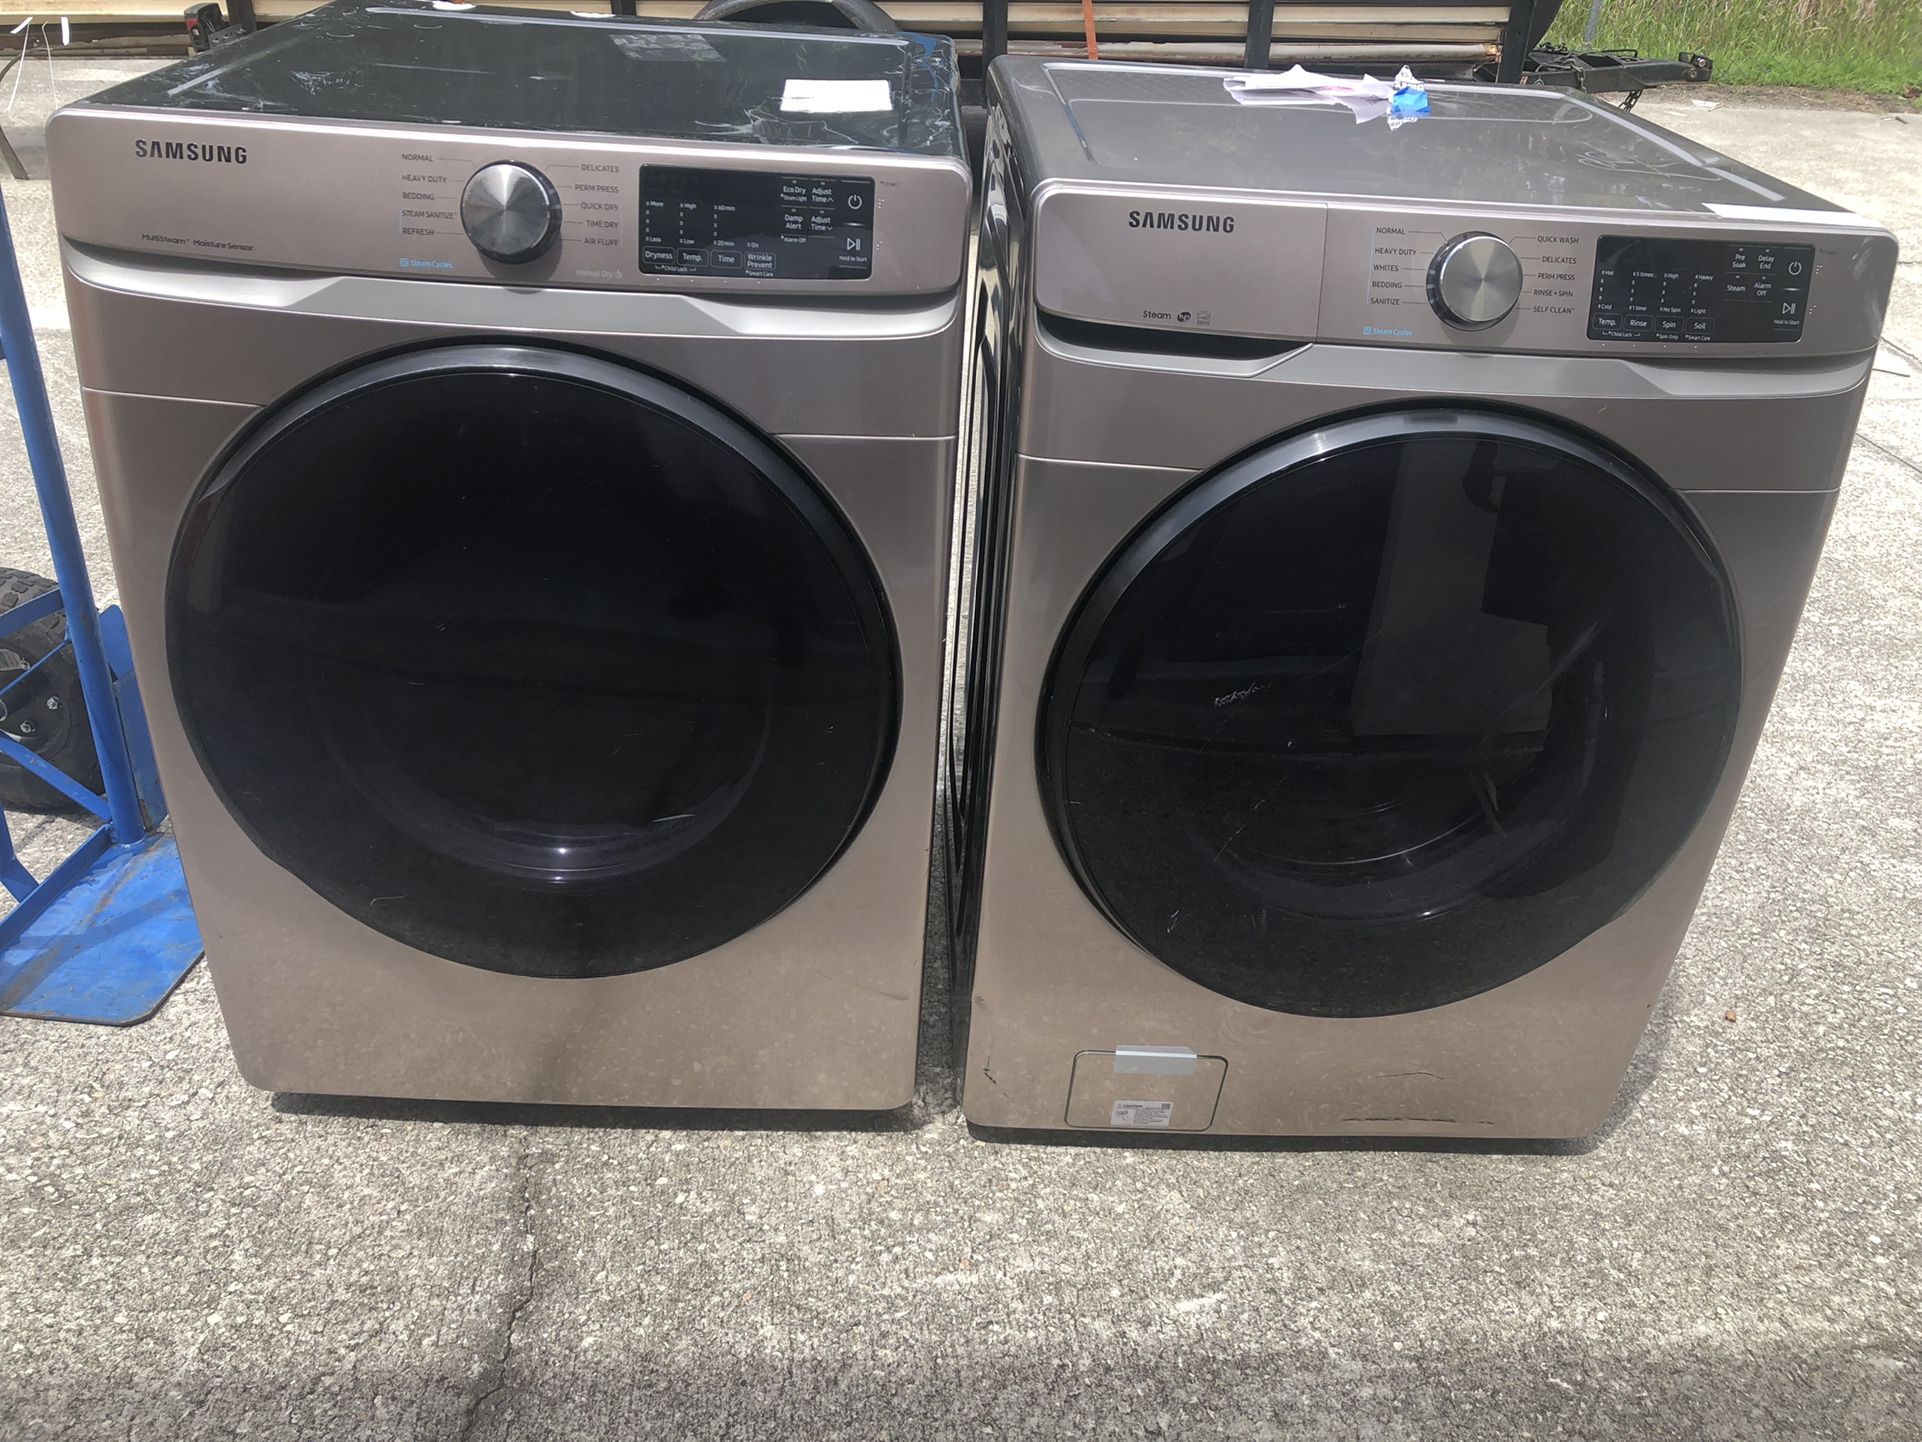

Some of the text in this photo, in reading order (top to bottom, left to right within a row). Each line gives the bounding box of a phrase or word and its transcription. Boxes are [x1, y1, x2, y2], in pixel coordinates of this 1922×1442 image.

[135, 139, 247, 164] SAMSUNG
[401, 153, 433, 162] NORMAL
[580, 163, 620, 173] DELICATES
[401, 174, 448, 183] HEAVY DUTY
[574, 183, 619, 194] PERM PRESS
[783, 186, 806, 195] Eco Dry
[811, 187, 832, 196] Adjust
[401, 191, 435, 201] BEDDING
[580, 201, 619, 211] QUICK DRY
[684, 202, 697, 211] High
[401, 209, 425, 217] STEAM
[784, 213, 803, 223] Damp
[810, 216, 831, 225] Adjust
[1128, 210, 1235, 234] SAMSUNG
[585, 219, 619, 229] TIME DRY
[785, 222, 802, 230] Alert
[811, 223, 827, 231] Time
[401, 226, 435, 236] REFRESH
[1376, 227, 1406, 235] NORMAL
[583, 237, 619, 246] AIR FLUFF
[1537, 235, 1579, 244] QUICK WASH
[193, 239, 227, 249] Moisture
[227, 241, 254, 251] Sensor
[750, 241, 760, 249] On
[644, 250, 674, 261] Dryness
[1374, 247, 1418, 256] HEAVY DUTY
[717, 254, 735, 264] Time
[746, 253, 773, 262] Wrinkle
[1541, 255, 1577, 265] DELICATES
[1734, 253, 1746, 261] Pre
[1758, 254, 1775, 264] Delay
[746, 261, 773, 270] Prevent
[1373, 264, 1399, 272] WHITES
[1732, 261, 1747, 269] Soak
[1759, 262, 1772, 270] End
[1537, 272, 1576, 281] PERM PRESS
[1371, 281, 1403, 289] BEDDING
[1726, 284, 1747, 293] Steam
[1753, 282, 1772, 290] Alarm
[1533, 289, 1553, 297] RINSE
[1756, 289, 1768, 297] Off
[1370, 297, 1401, 305] SANITIZE
[1533, 305, 1550, 313] SELF
[1142, 310, 1172, 320] Steam
[1629, 319, 1648, 327] Rinse
[1662, 320, 1677, 329] Spin
[1694, 321, 1707, 330] Soil
